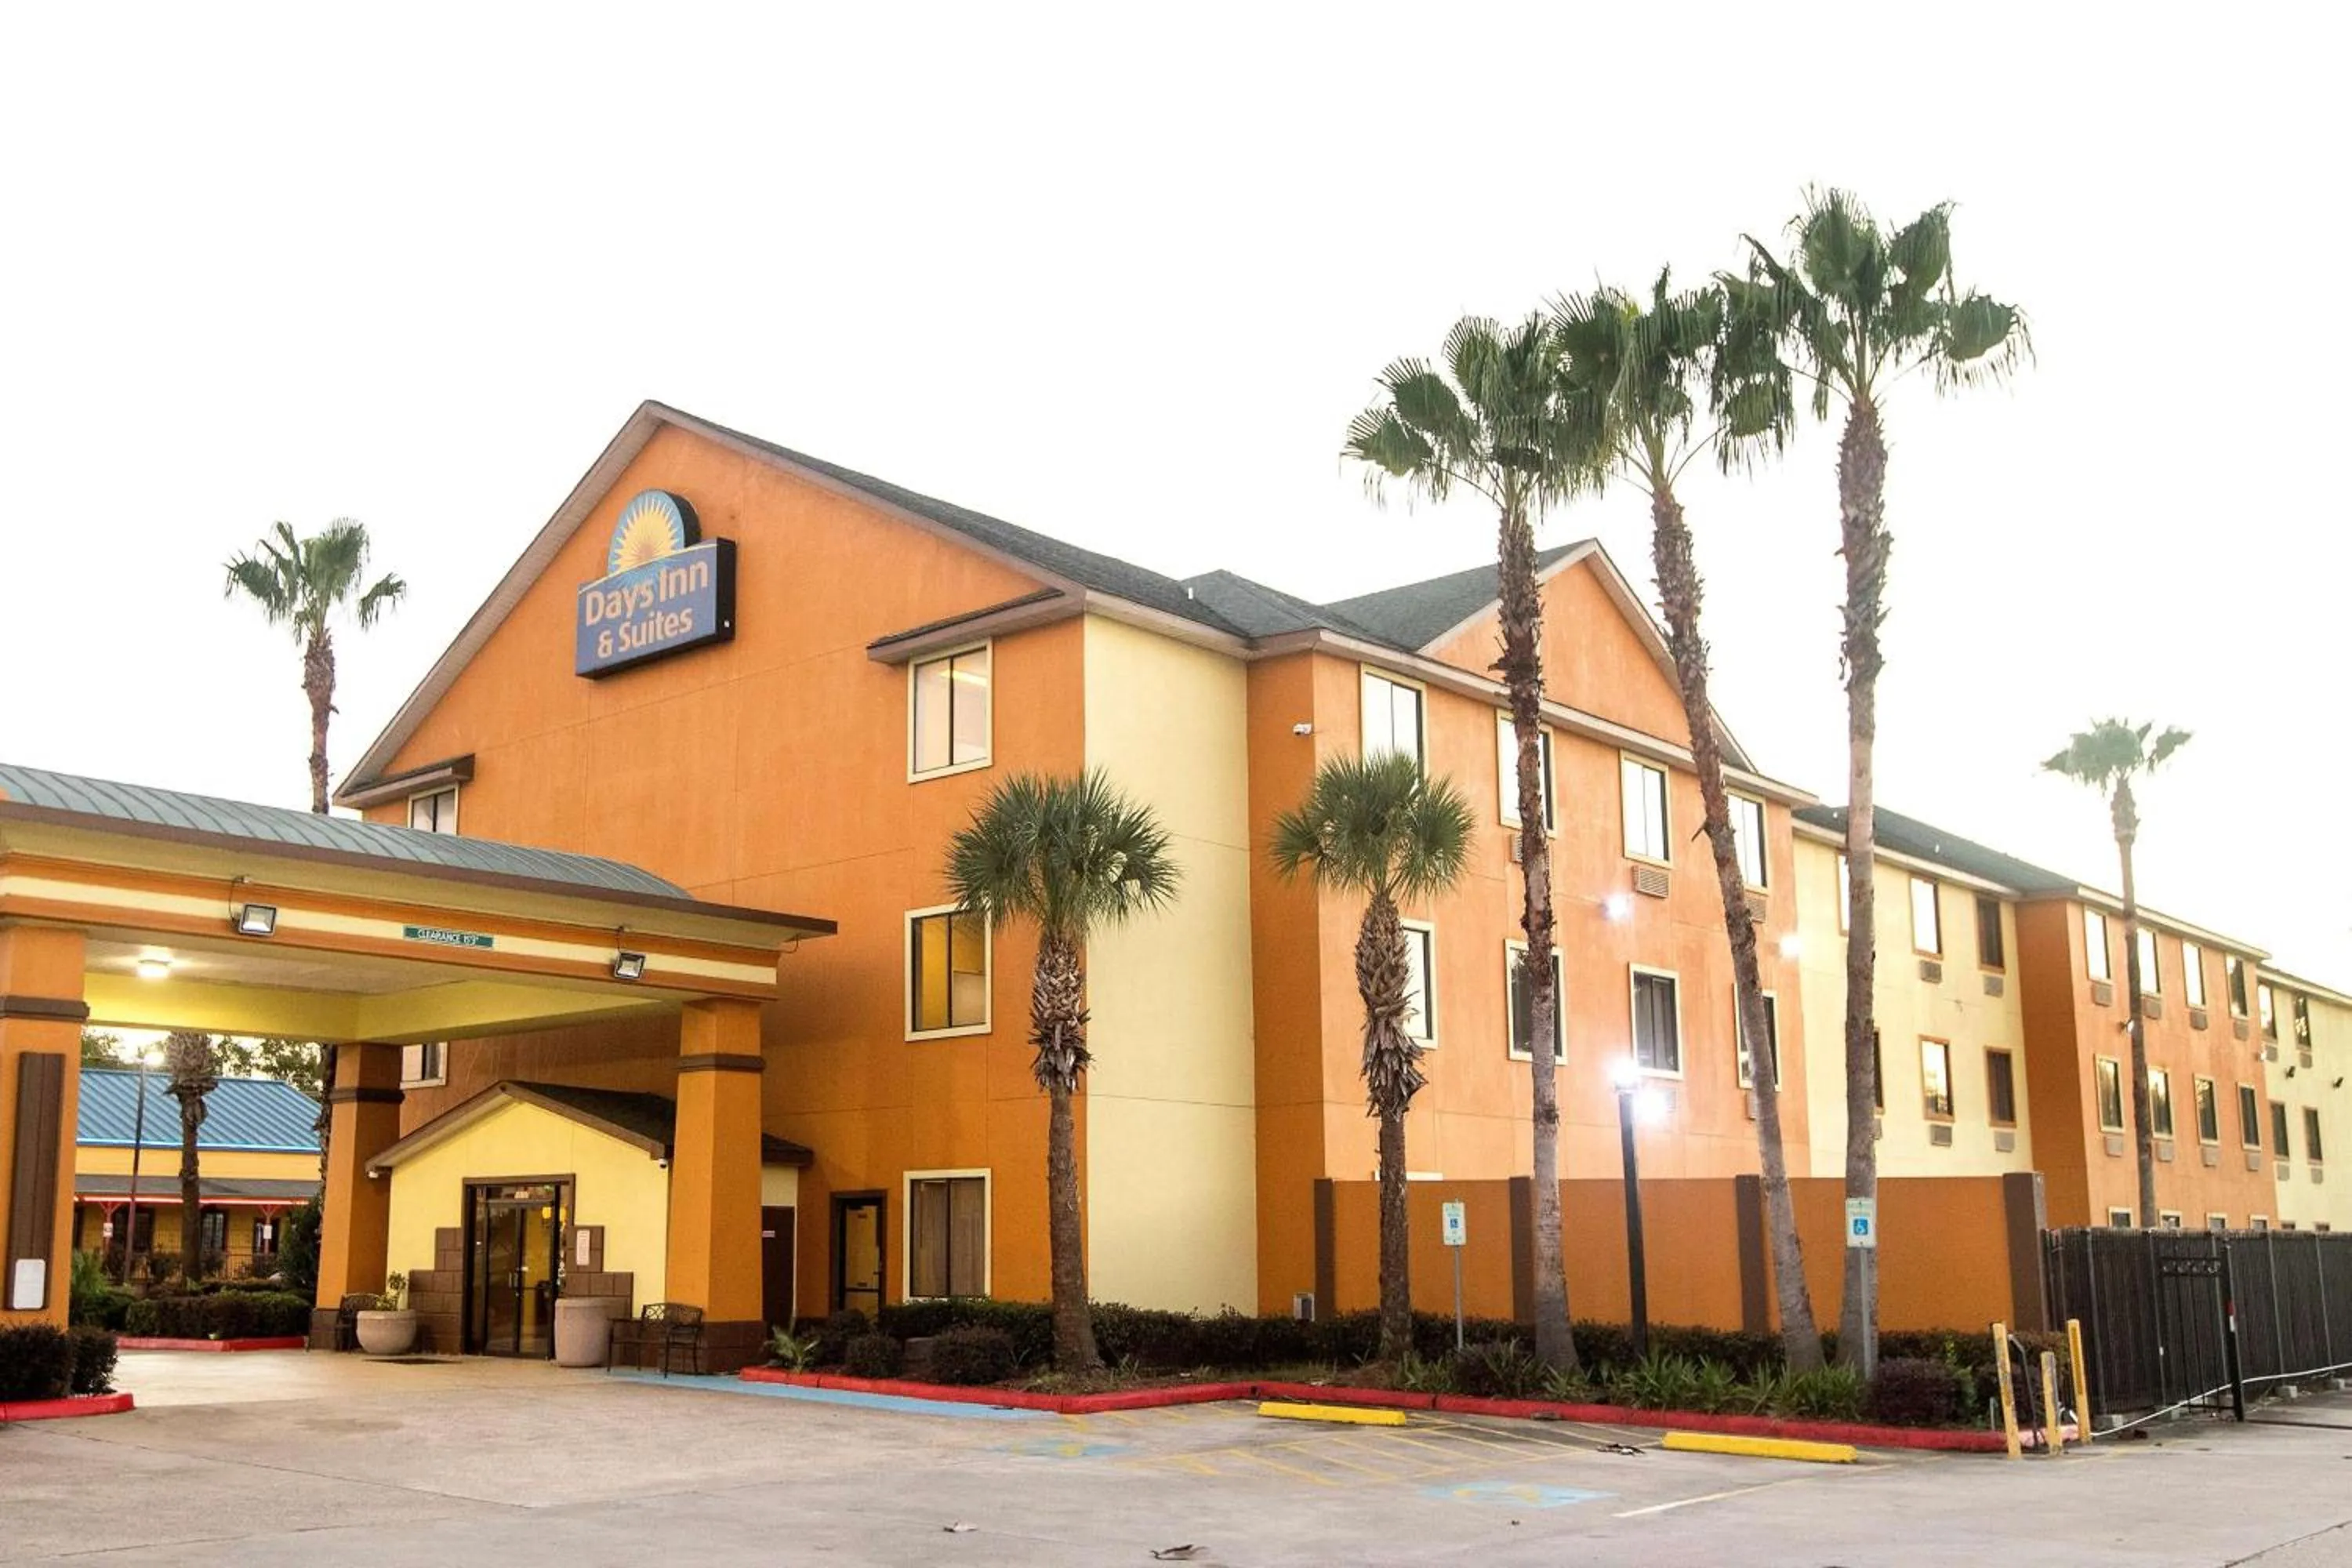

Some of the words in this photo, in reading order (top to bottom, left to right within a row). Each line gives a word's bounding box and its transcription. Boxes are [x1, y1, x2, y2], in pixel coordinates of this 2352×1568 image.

[586, 579, 654, 626] Days
[659, 561, 708, 603] Inn
[597, 630, 614, 659] &
[618, 608, 693, 652] Suites
[417, 928, 460, 943] CLEARANCE
